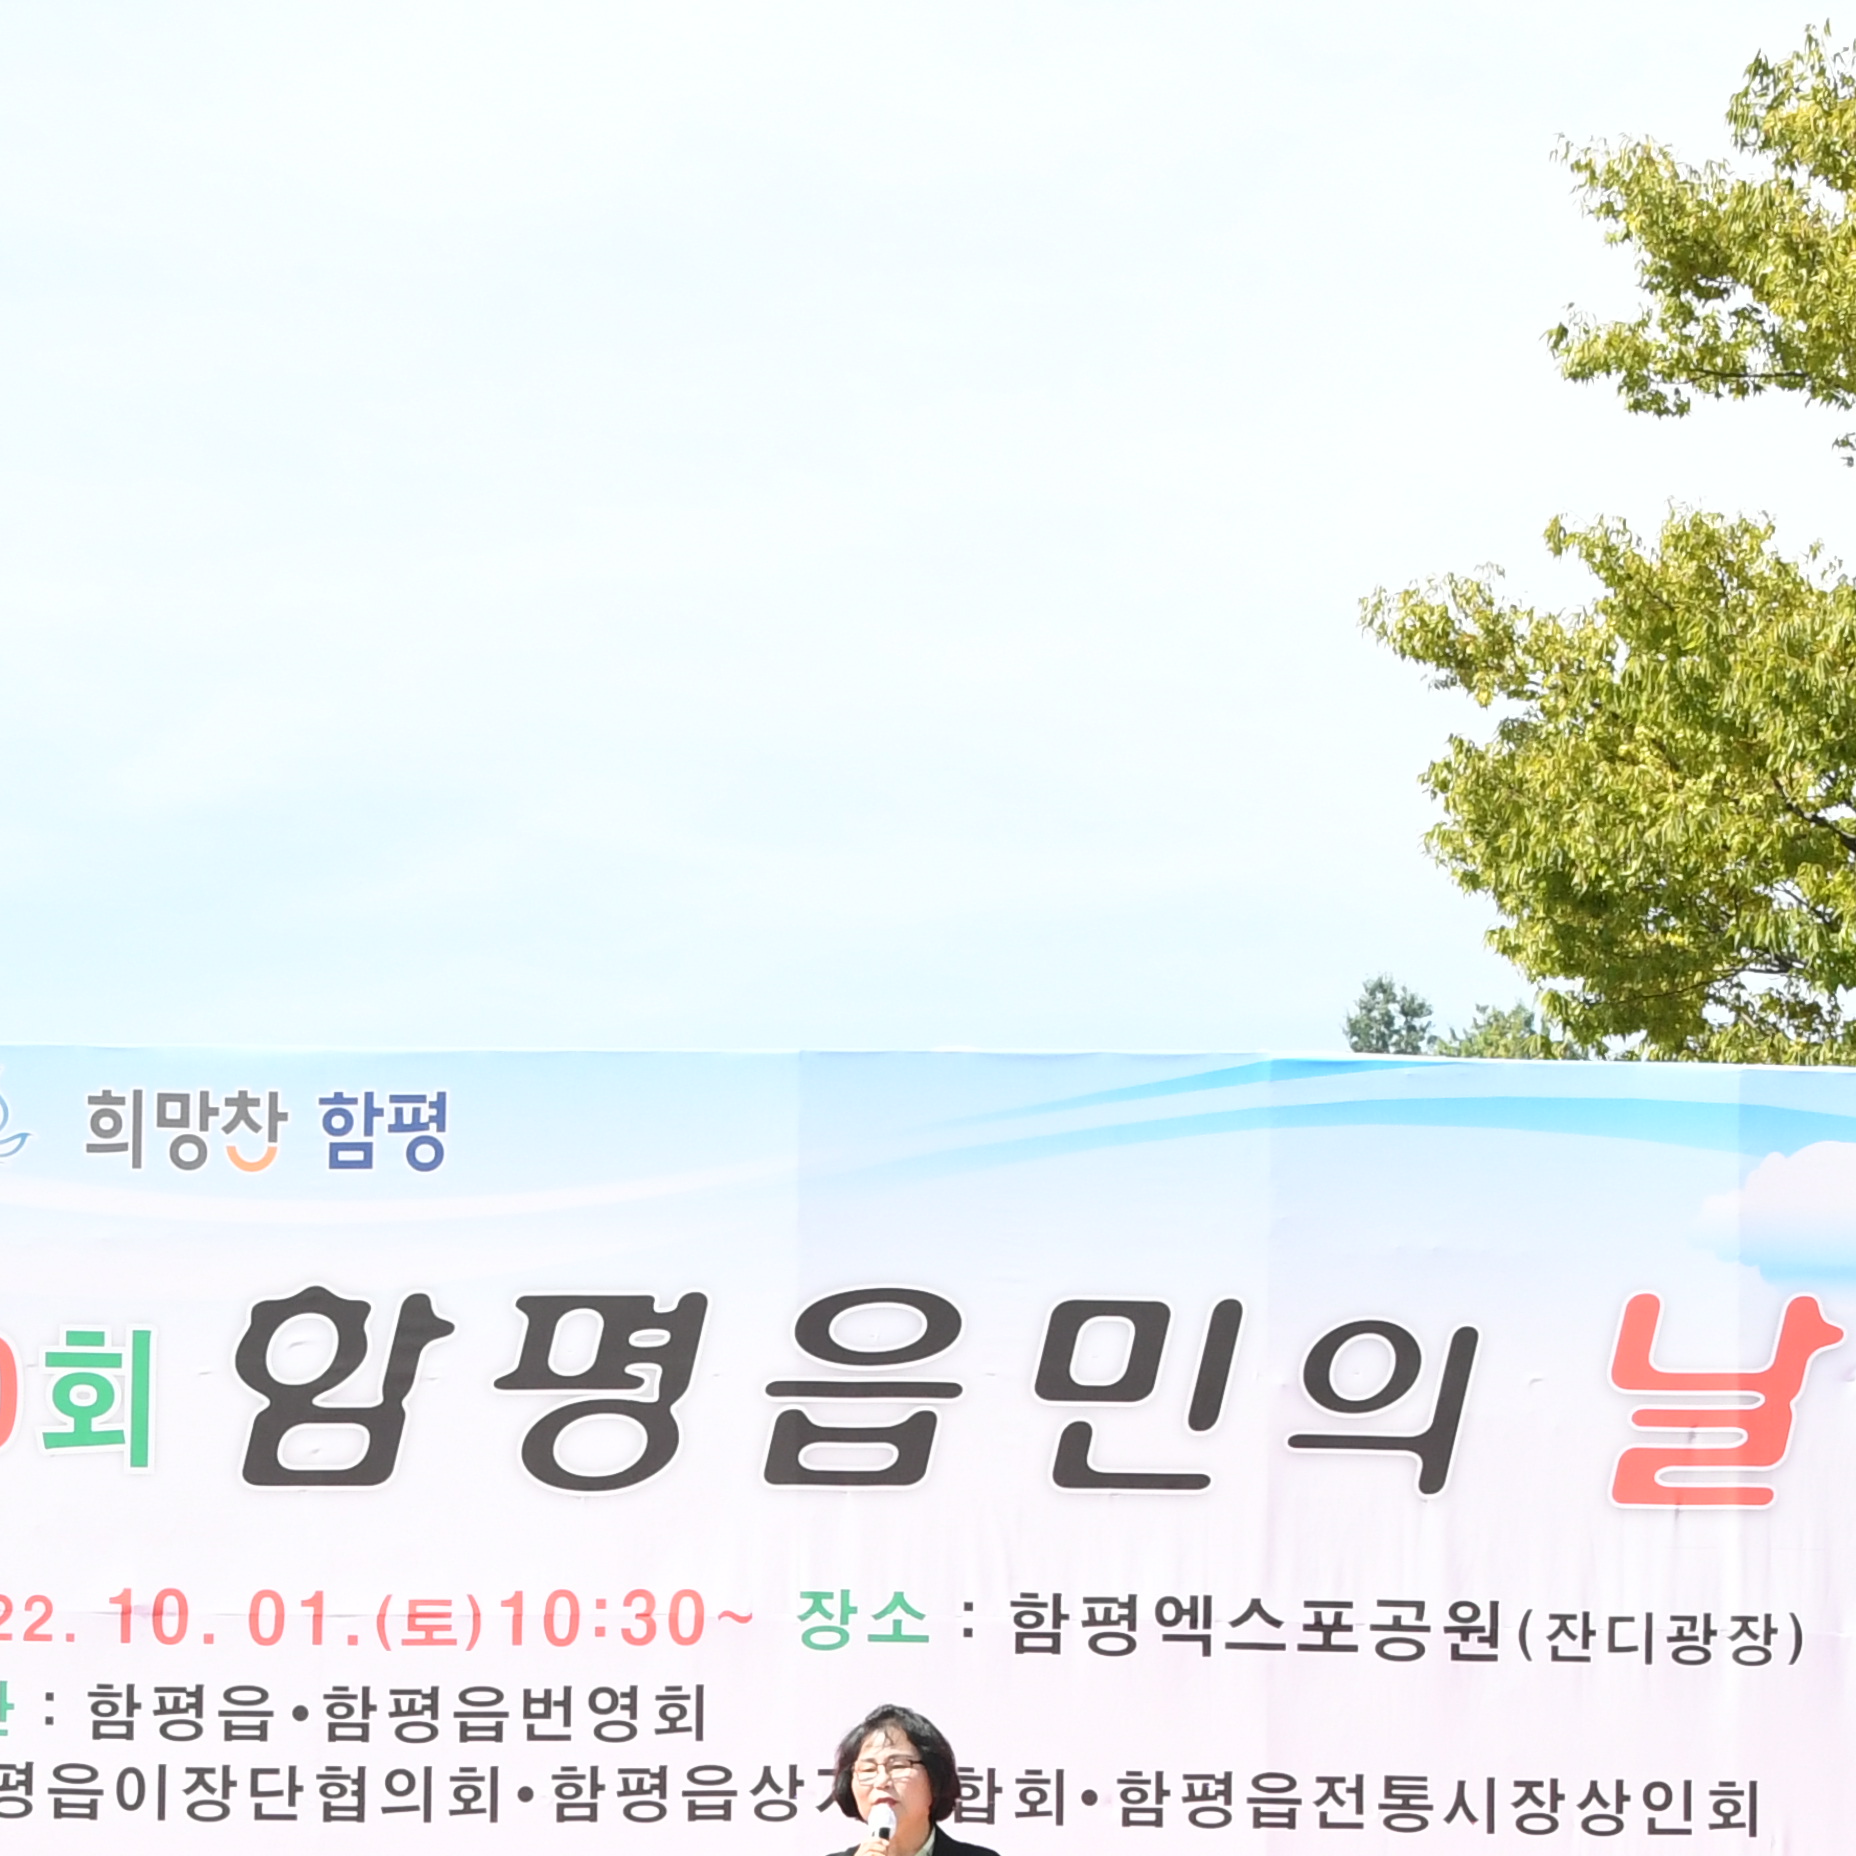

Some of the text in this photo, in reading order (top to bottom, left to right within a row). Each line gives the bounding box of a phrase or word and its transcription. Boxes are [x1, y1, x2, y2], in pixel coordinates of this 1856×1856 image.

[85, 1088, 447, 1172] 희망찬 함평
[1611, 1293, 1844, 1506] 날
[797, 1589, 931, 1651] 장소
